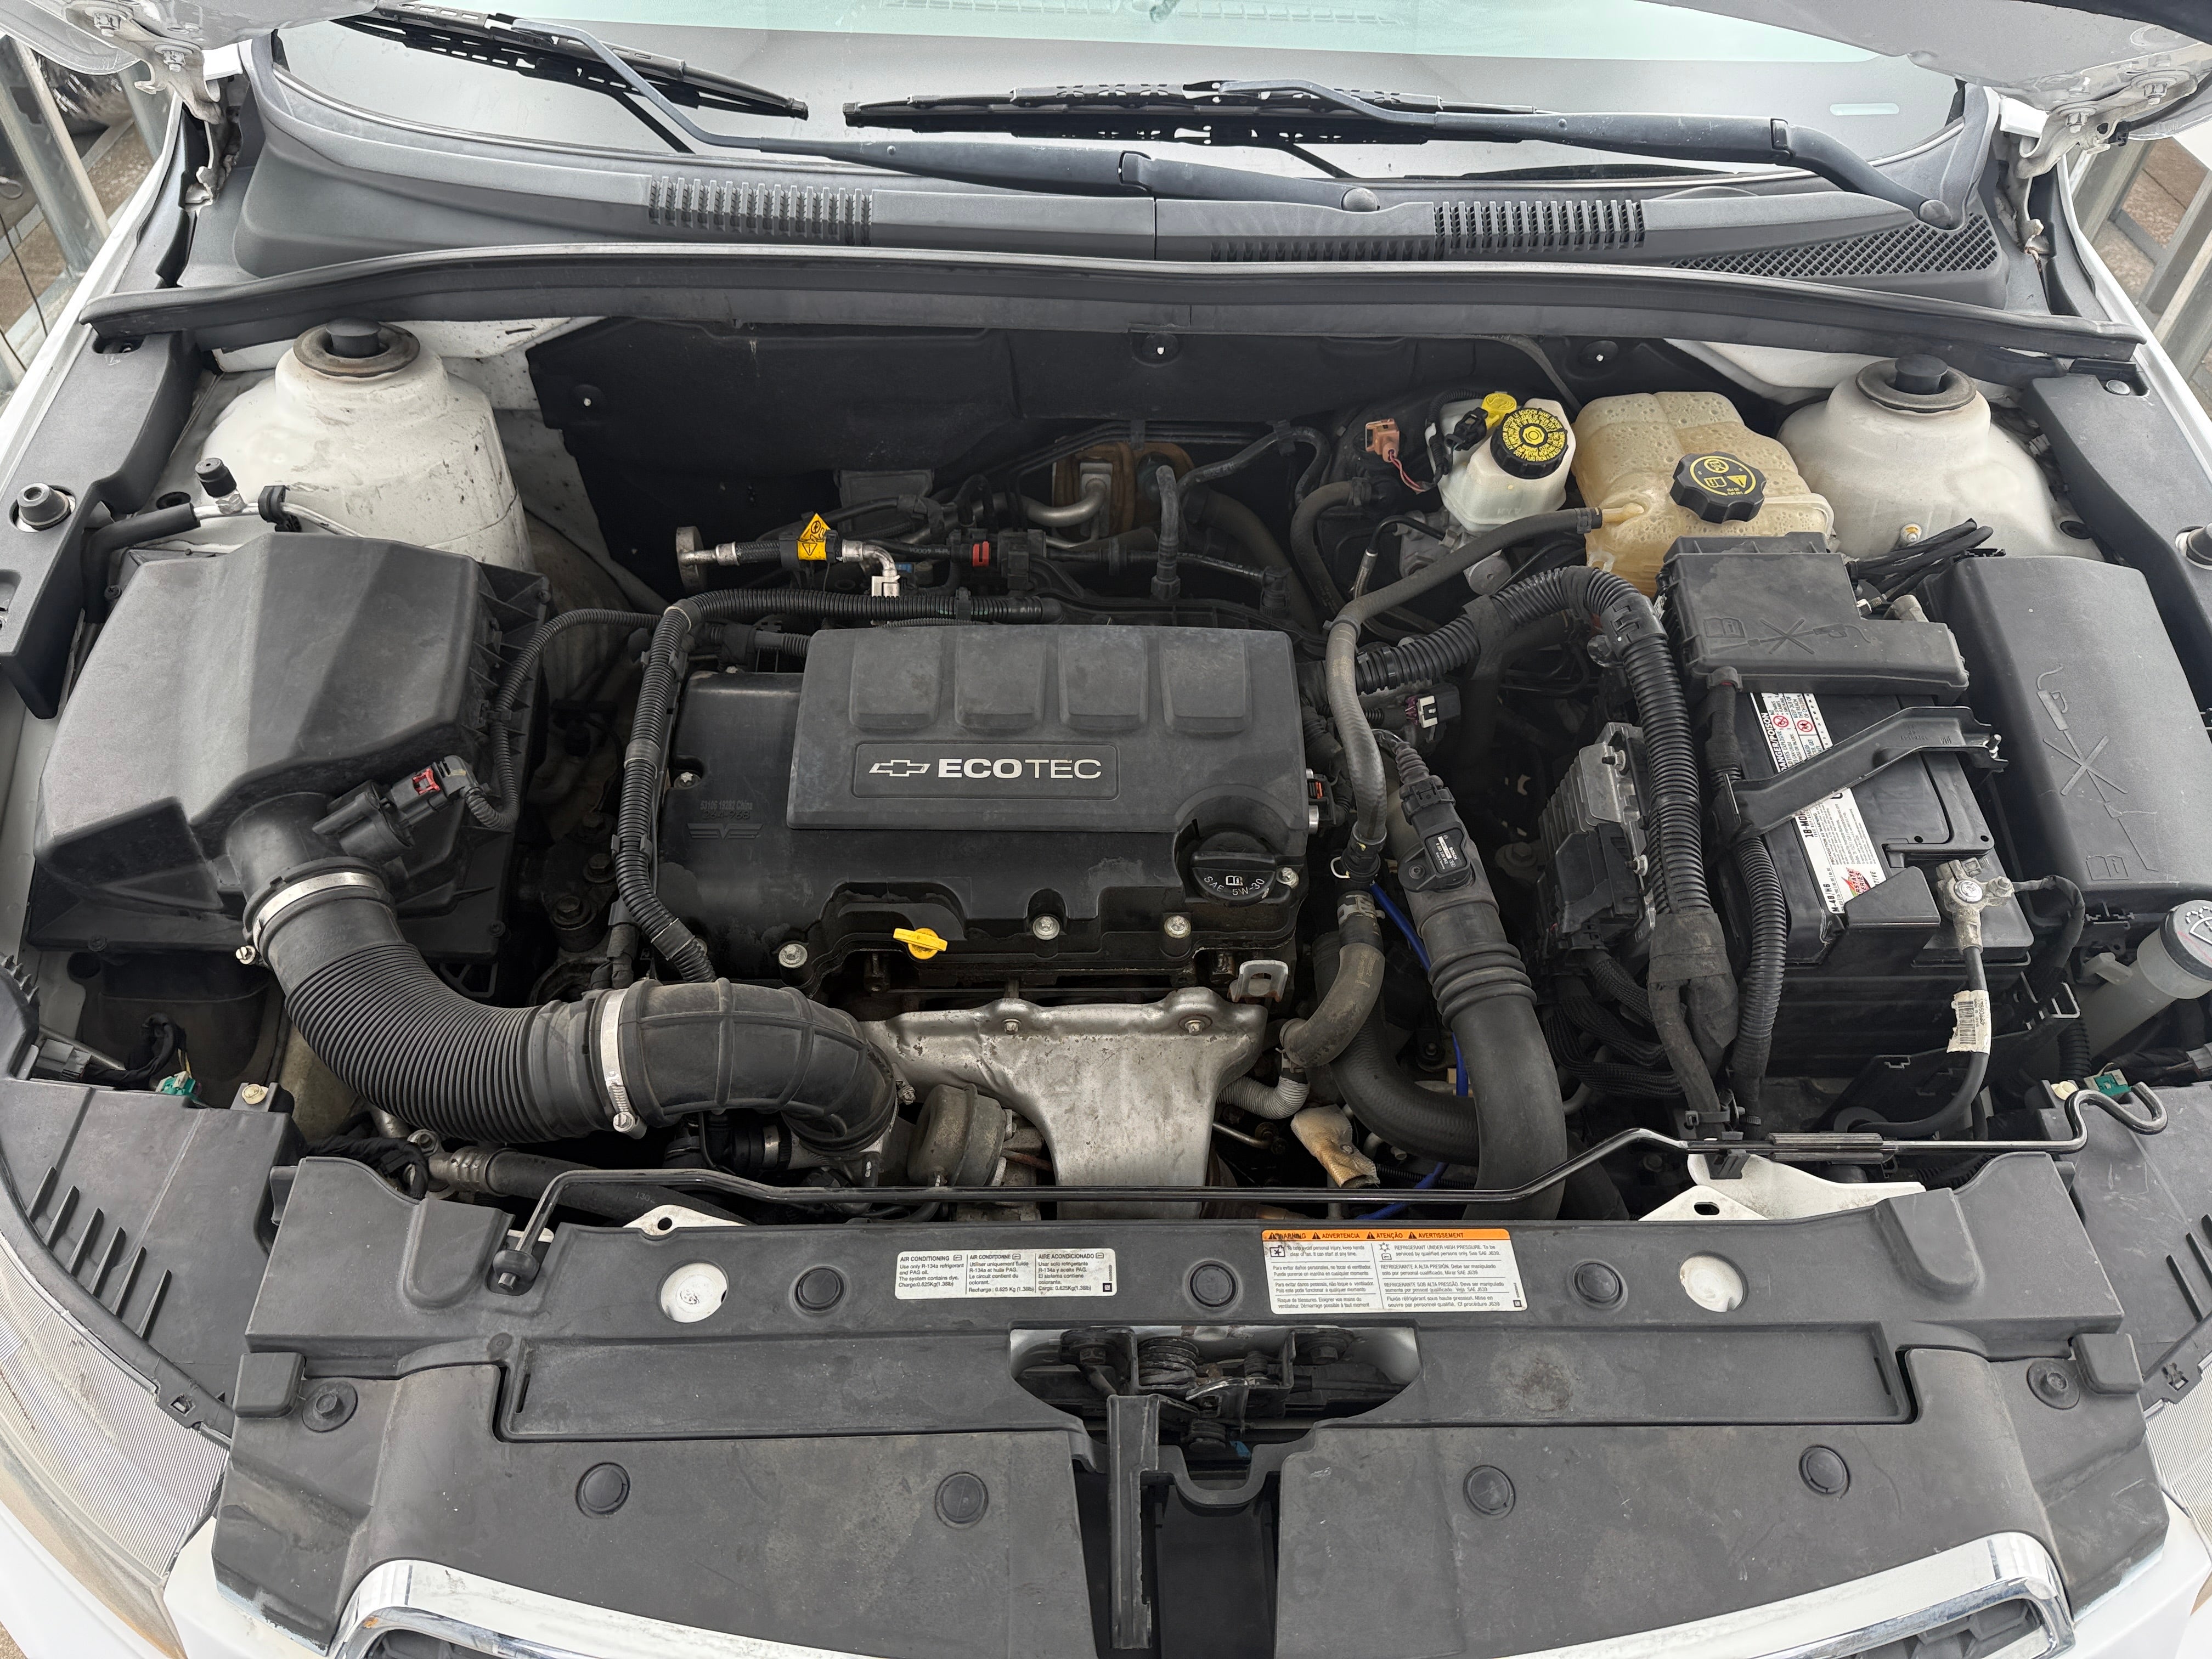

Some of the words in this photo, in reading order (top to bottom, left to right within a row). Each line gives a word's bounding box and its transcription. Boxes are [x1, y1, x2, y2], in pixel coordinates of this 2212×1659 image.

[938, 758, 1102, 779] ECOTEC
[737, 799, 753, 810] China
[702, 810, 751, 820] 264-968
[1449, 847, 1458, 860] BOSCH
[1204, 876, 1224, 892] SAE
[1232, 878, 1265, 896] 5W-30
